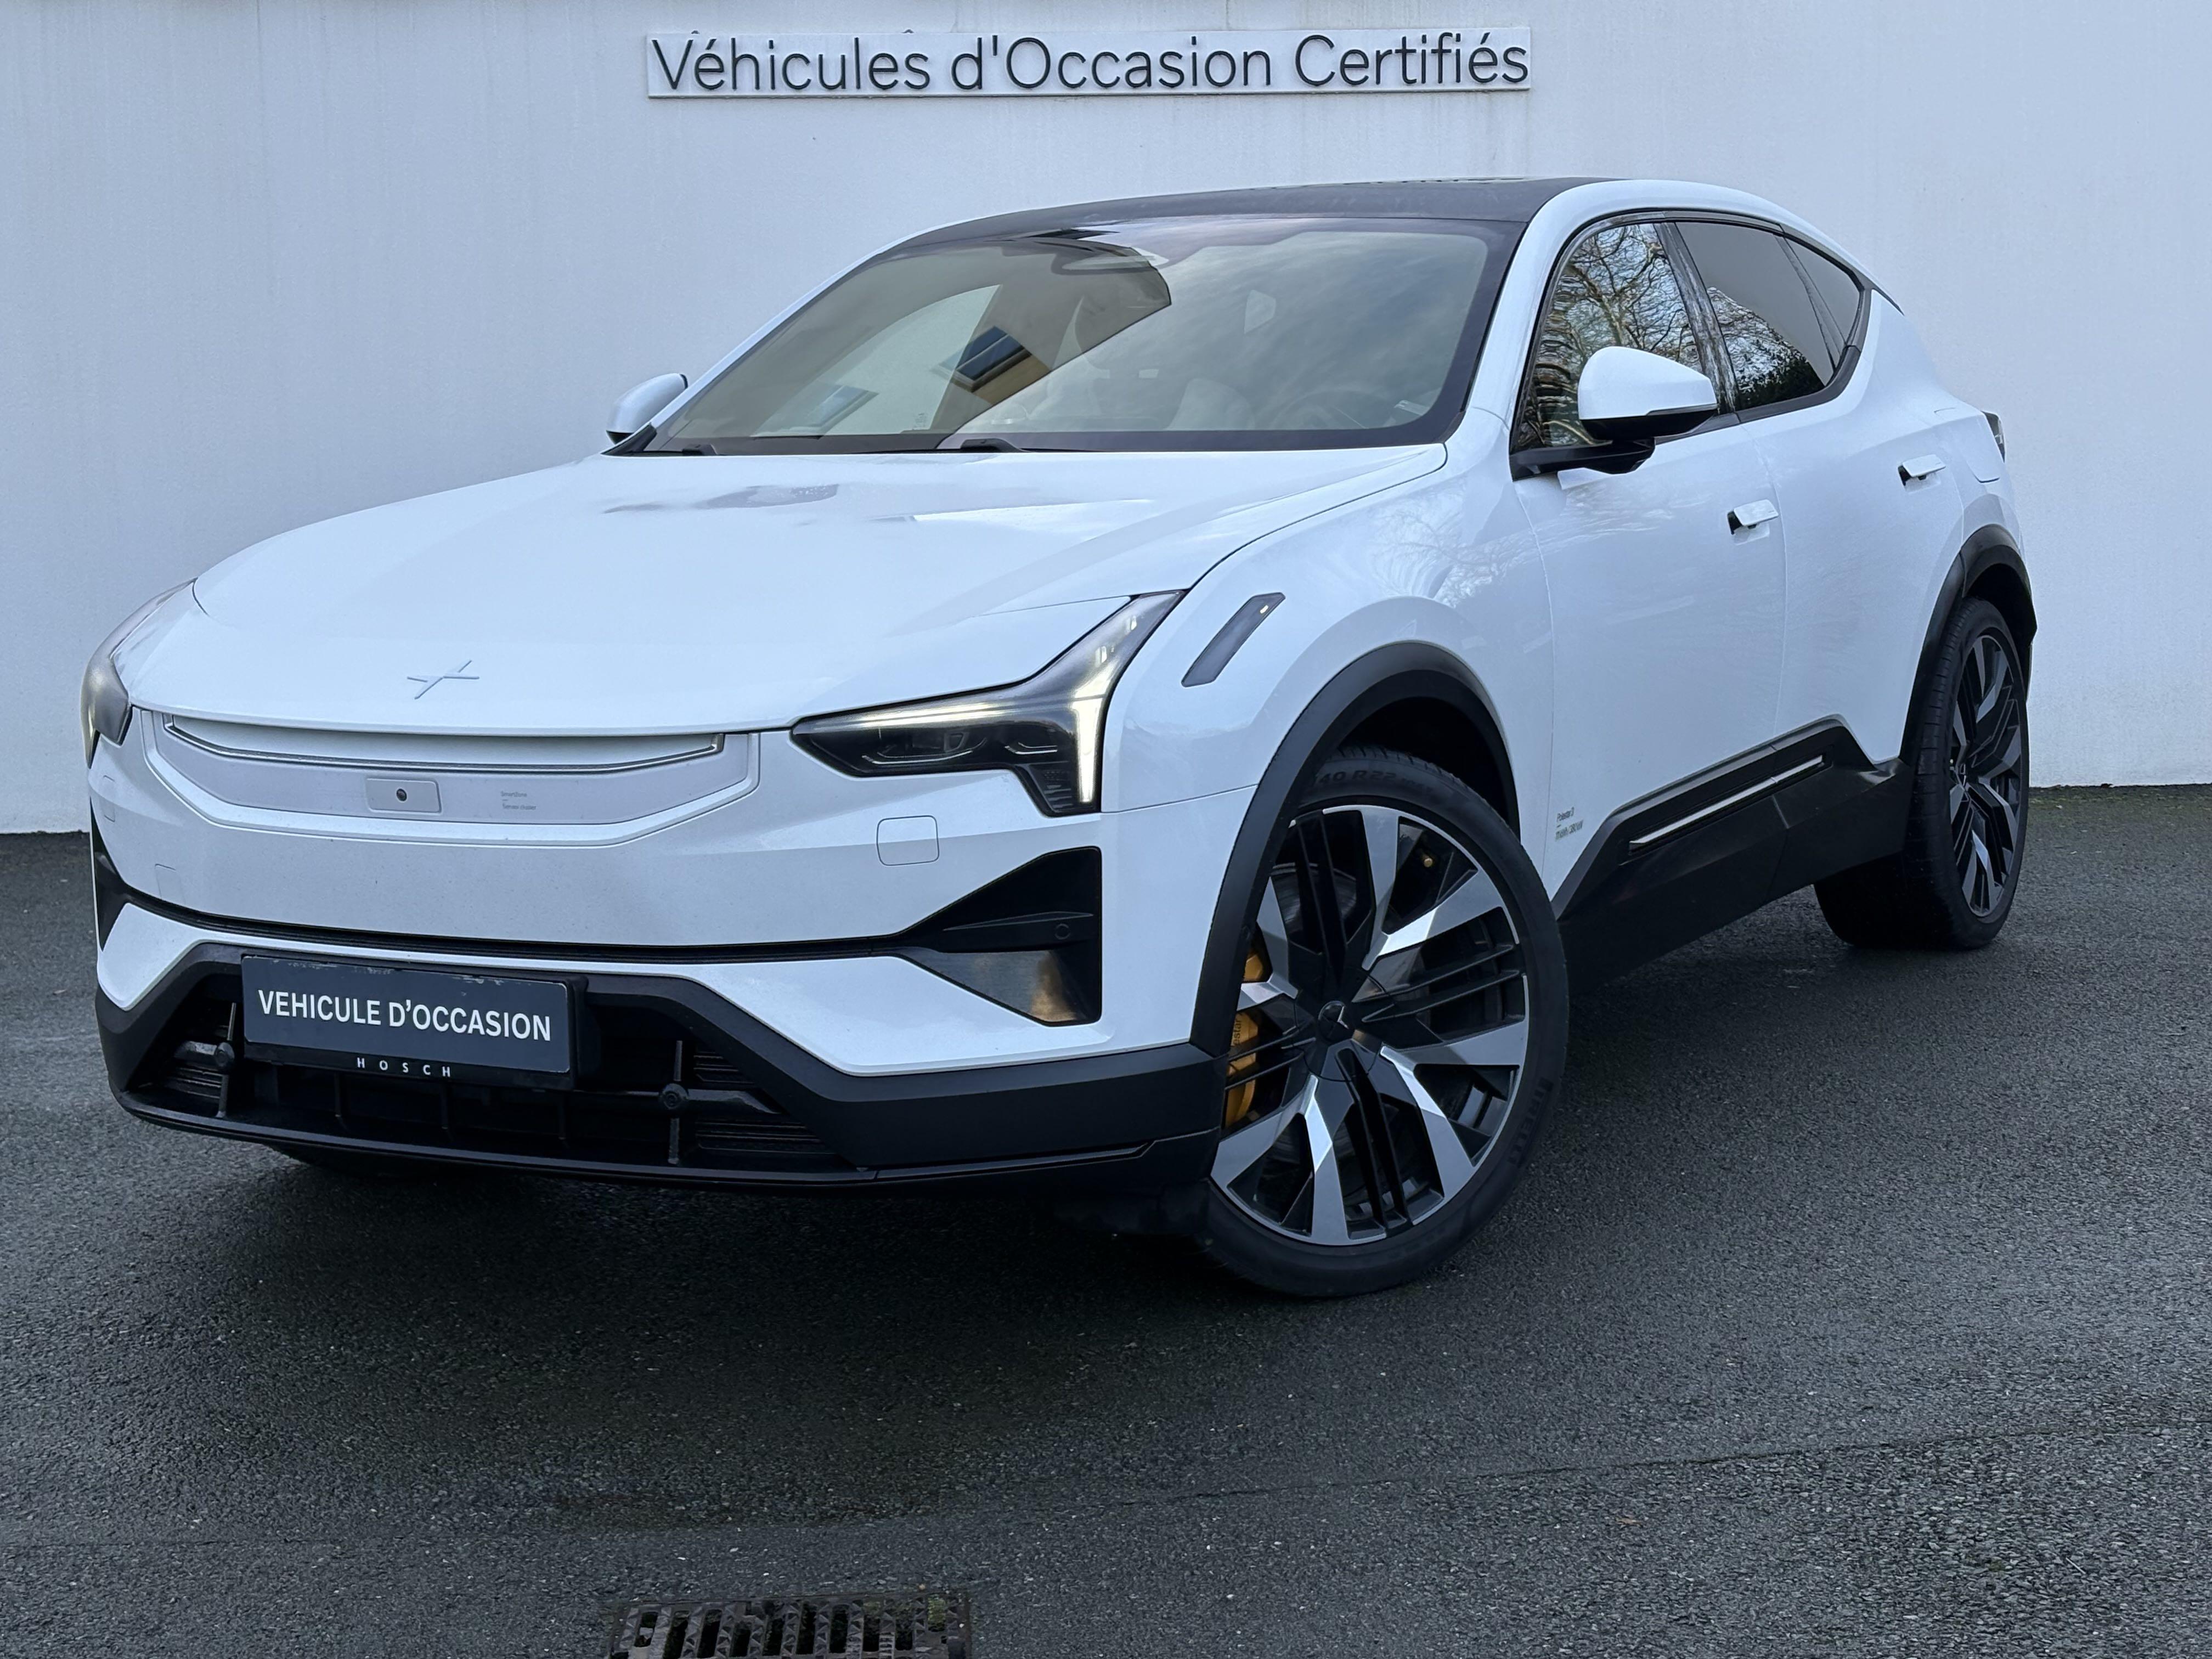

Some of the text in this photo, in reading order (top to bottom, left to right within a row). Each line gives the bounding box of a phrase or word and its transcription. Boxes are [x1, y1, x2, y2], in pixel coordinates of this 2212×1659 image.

[651, 31, 1528, 92] Véhicules d'Occasion Certifiés
[258, 989, 382, 1026] VEHICULE
[357, 1057, 451, 1077] HOSCH
